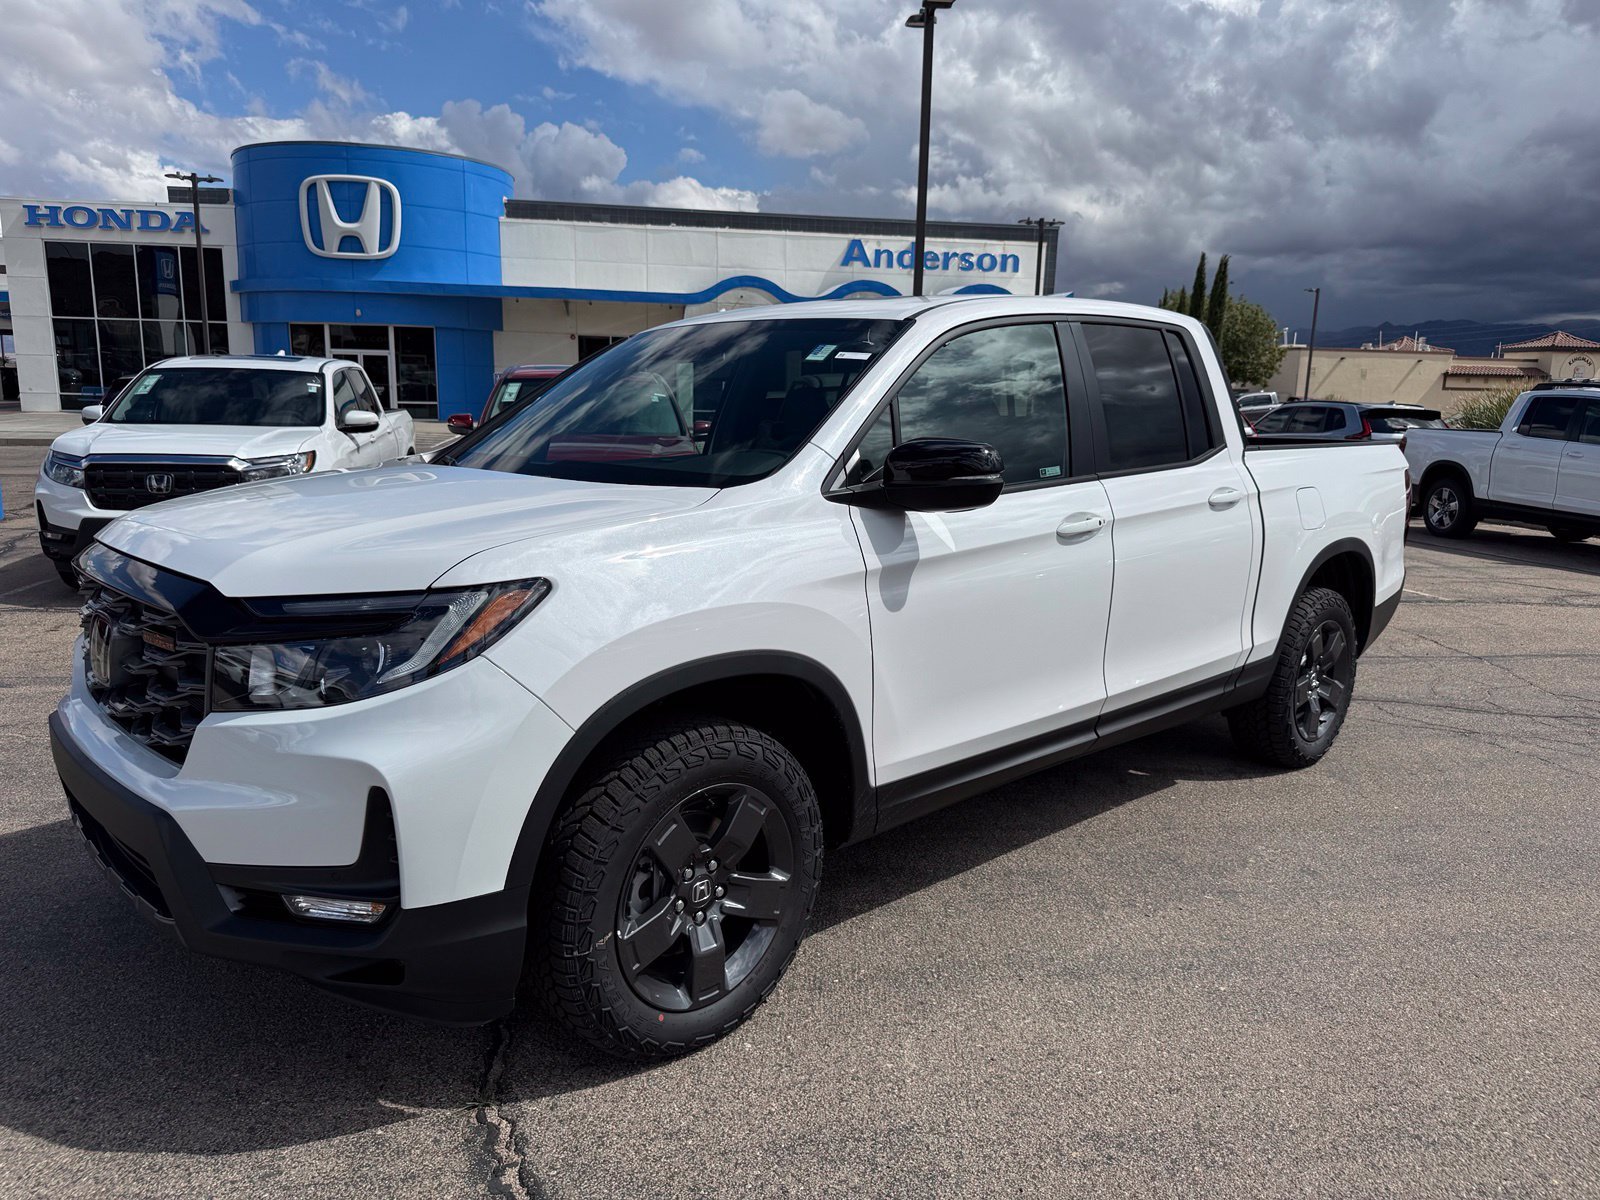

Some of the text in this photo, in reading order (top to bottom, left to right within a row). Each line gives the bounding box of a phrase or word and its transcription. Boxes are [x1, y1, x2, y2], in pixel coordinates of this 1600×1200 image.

[23, 205, 210, 234] HONDA
[840, 239, 1020, 273] Anderson
[1568, 356, 1593, 366] KINGMAN
